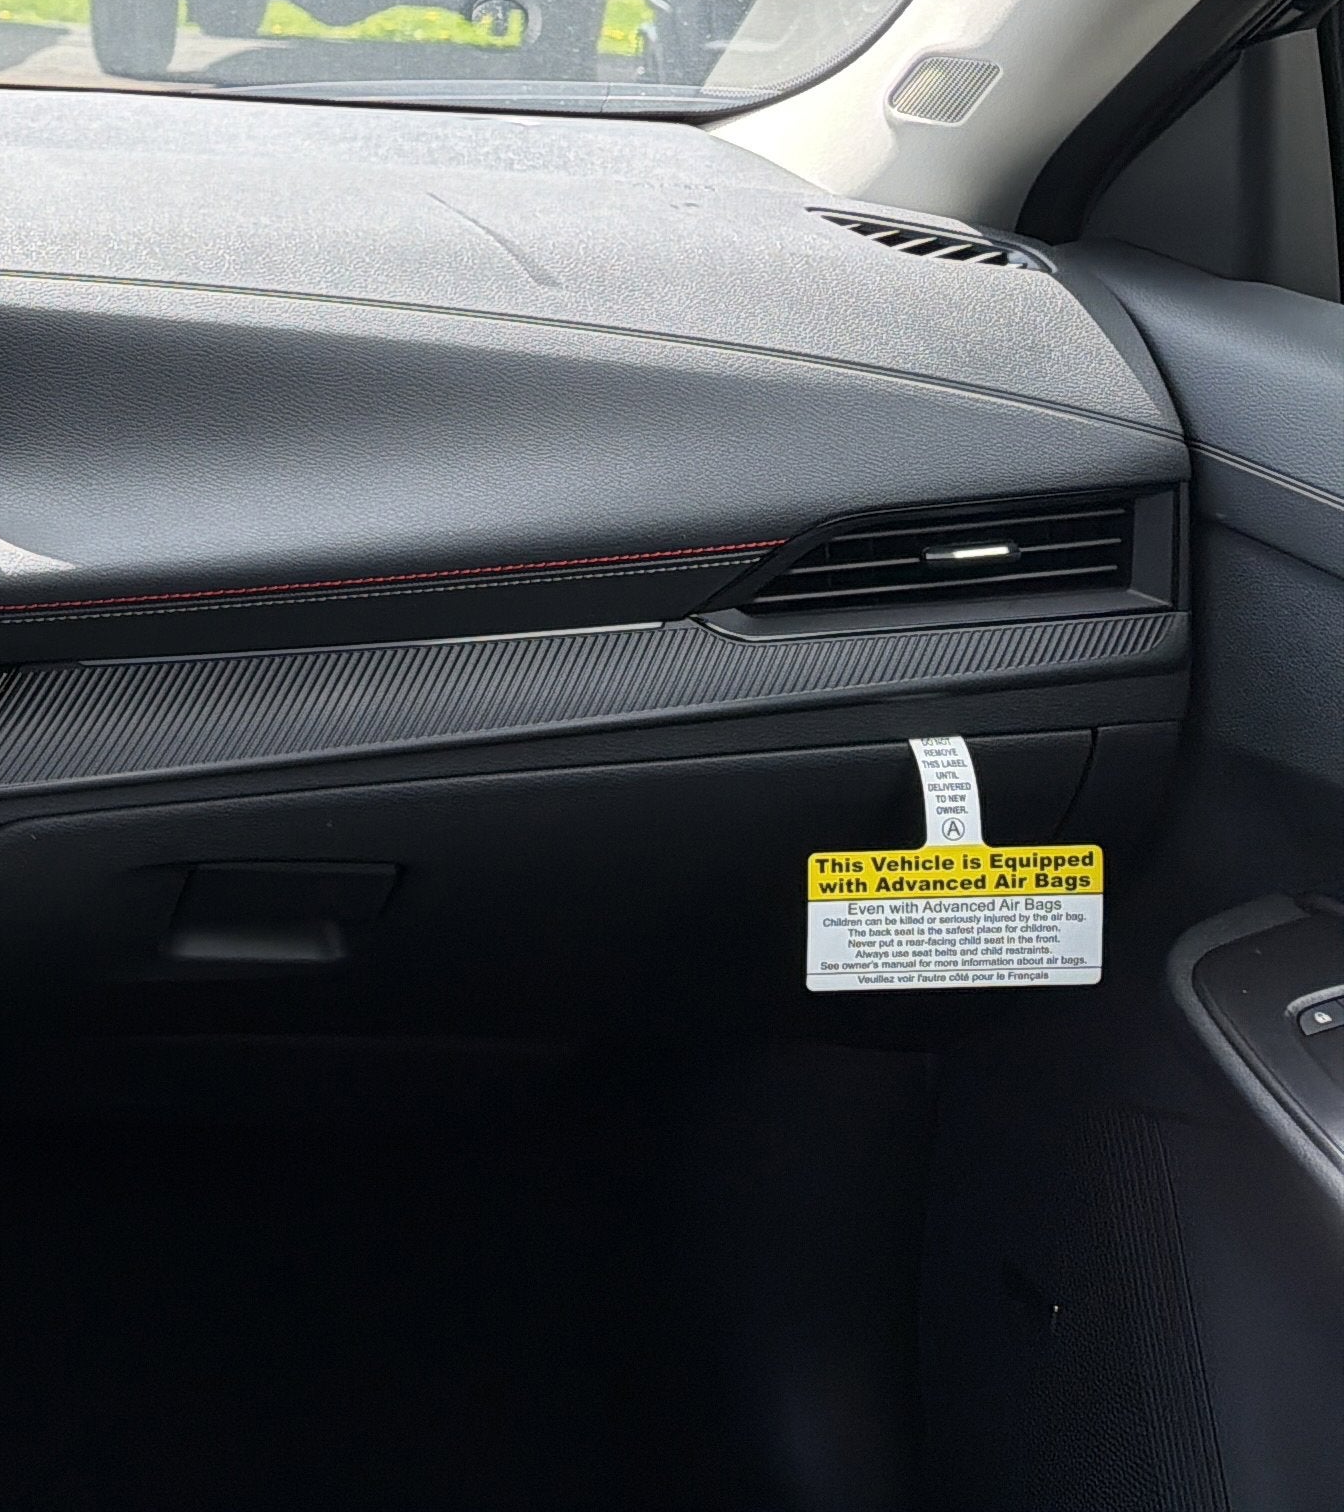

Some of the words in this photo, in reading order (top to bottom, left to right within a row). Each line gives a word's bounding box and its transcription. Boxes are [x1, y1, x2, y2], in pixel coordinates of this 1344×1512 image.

[924, 748, 958, 757] REMOVE
[922, 760, 940, 768] THIS
[942, 759, 968, 768] LABEL
[936, 771, 959, 780] UNTIL
[928, 782, 971, 792] DELIVERED
[935, 794, 946, 803] TO
[948, 794, 966, 802] NEW
[936, 806, 968, 815] OWNER.
[815, 857, 864, 873] This
[871, 855, 955, 872] Vehicle
[963, 854, 981, 869] is
[990, 851, 1094, 872] Equipped
[819, 878, 868, 894] with
[875, 874, 986, 892] Advanced
[994, 873, 1027, 889] Air
[1035, 873, 1091, 891] Bags
[848, 902, 884, 915] Even
[889, 901, 918, 914] with
[922, 899, 995, 914] Advanced
[999, 899, 1020, 912] Air
[1025, 898, 1062, 913] Bags
[823, 918, 862, 927] Children
[885, 917, 897, 925] be
[900, 916, 924, 925] killed
[939, 914, 981, 925] seriously
[984, 913, 1016, 924] injured
[1019, 913, 1030, 923] by
[1033, 912, 1048, 921] the
[1051, 912, 1063, 920] air
[1066, 911, 1086, 922] bag.
[848, 929, 866, 937] The
[869, 928, 892, 936] back
[894, 928, 914, 936] seat
[917, 927, 925, 935] is
[928, 926, 942, 935] the
[946, 925, 974, 934] safest
[977, 925, 1002, 936] place
[1005, 924, 1017, 933] for
[1020, 923, 1061, 933] children.
[848, 939, 876, 948] Never
[879, 939, 894, 950] put
[906, 937, 956, 948] rear-facing
[959, 936, 981, 945] child
[984, 936, 1004, 944] seat
[1007, 935, 1015, 944] in
[1018, 935, 1033, 943] the
[1036, 934, 1060, 943] front.
[855, 950, 889, 960] Always
[912, 949, 932, 957] seat
[935, 948, 957, 957] belts
[960, 947, 978, 956] and
[981, 946, 1002, 955] child
[1006, 945, 1052, 955] restraints.
[821, 962, 840, 970] See
[842, 961, 878, 970] owner's
[882, 960, 916, 968] manual
[919, 959, 931, 967] for
[961, 956, 1014, 966] information
[1017, 956, 1047, 965] about
[1046, 956, 1058, 964] air
[1061, 956, 1087, 966] bags.
[858, 975, 894, 984] Veuillez
[917, 973, 946, 982] l'autre
[949, 972, 969, 981] côté
[972, 974, 994, 983] pour
[996, 972, 1005, 980] le
[1008, 971, 1049, 982] Français
